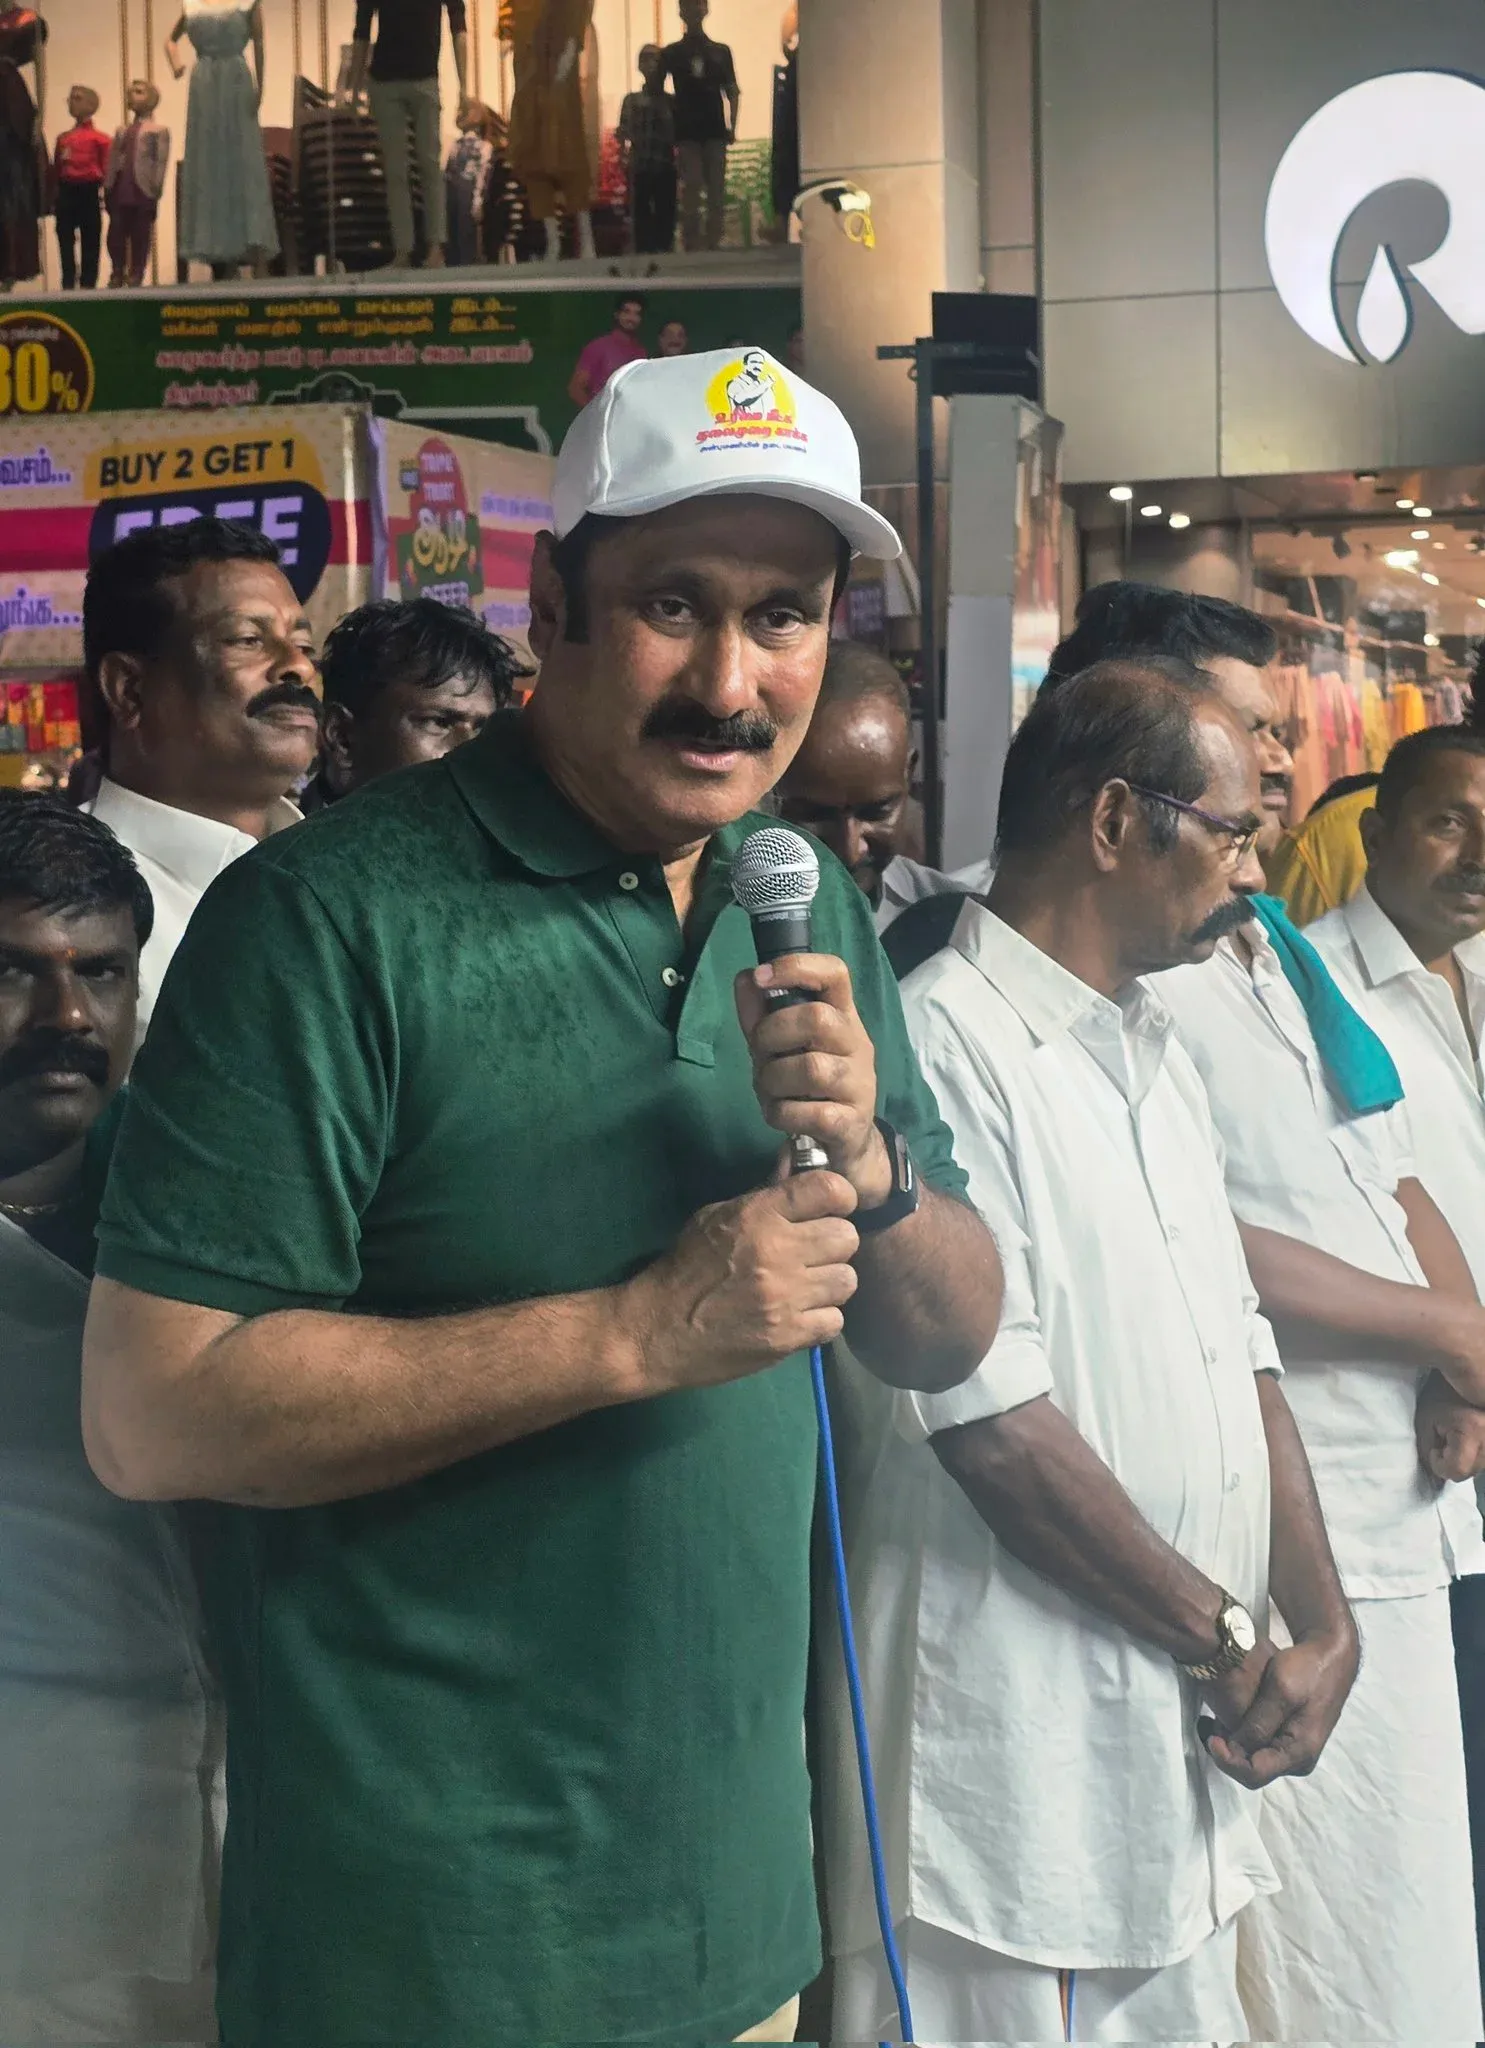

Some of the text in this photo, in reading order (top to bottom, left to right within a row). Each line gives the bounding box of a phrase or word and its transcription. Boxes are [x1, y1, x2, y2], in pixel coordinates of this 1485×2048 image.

[100, 438, 296, 488] BUY 2 GET 1
